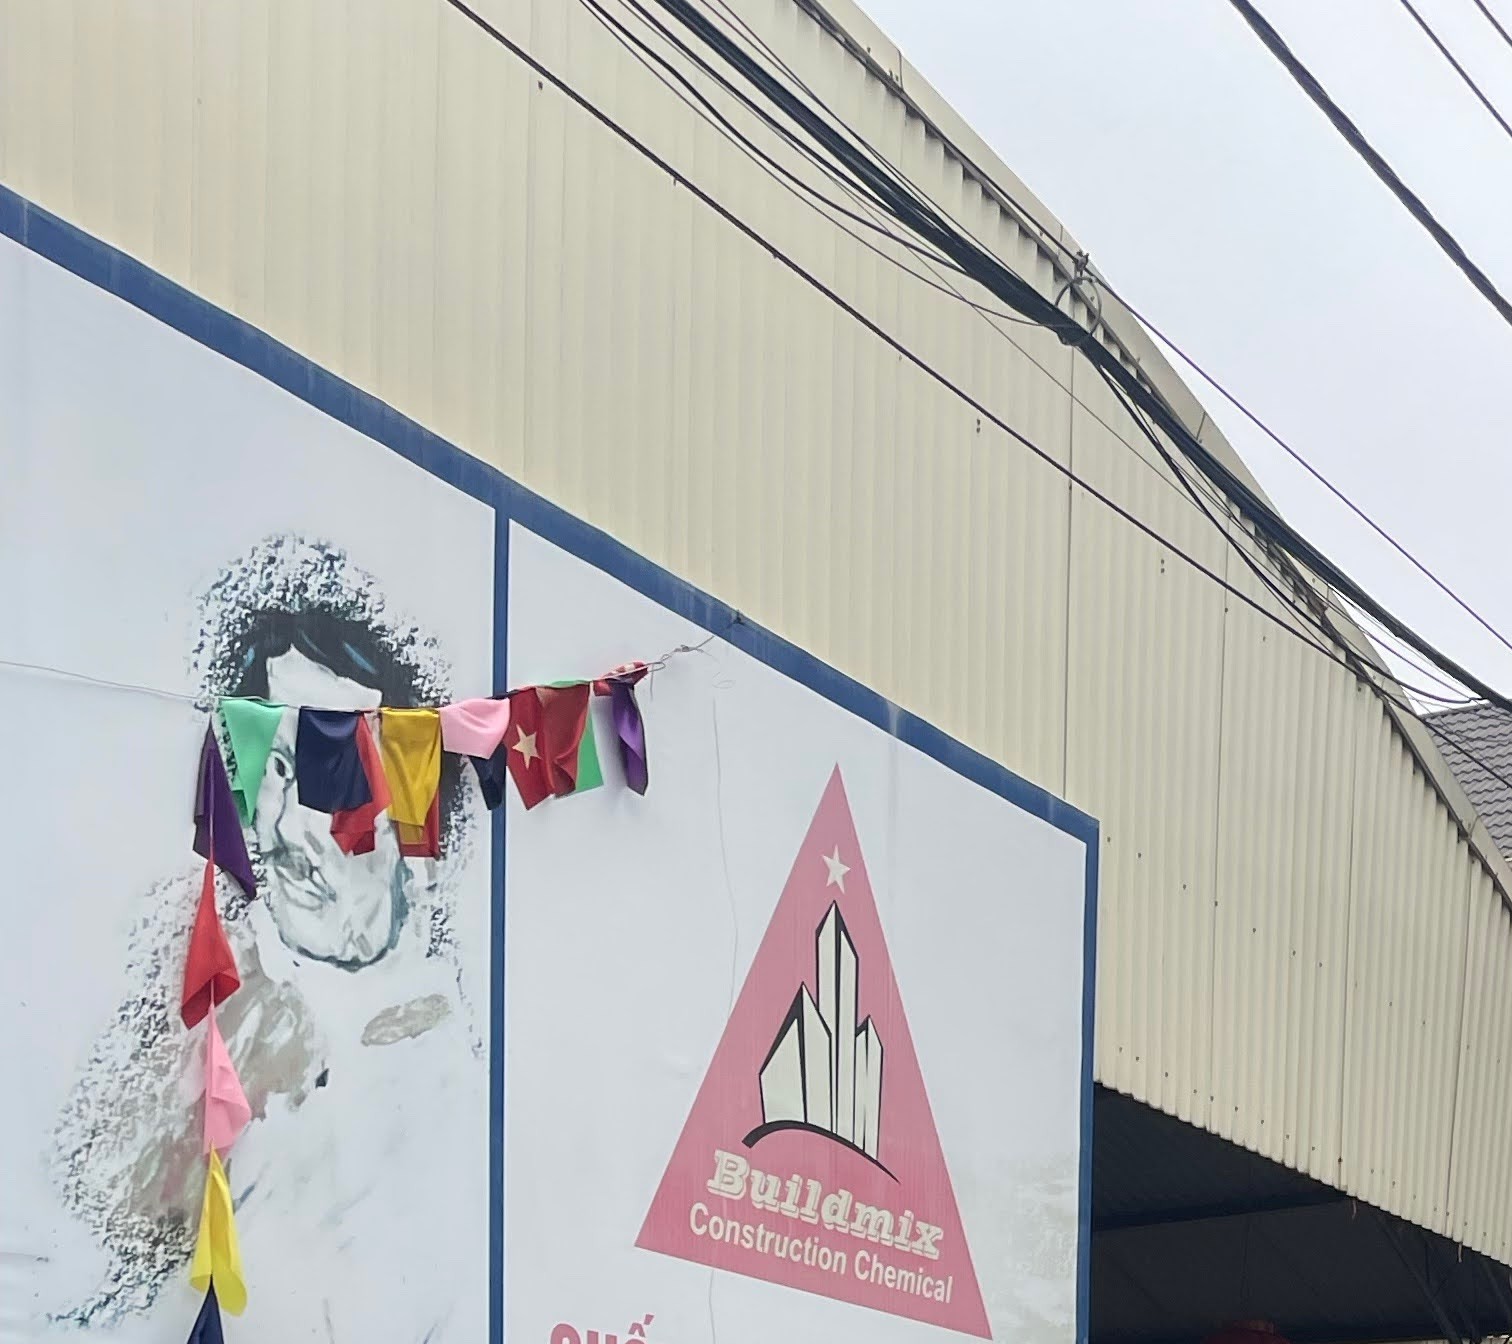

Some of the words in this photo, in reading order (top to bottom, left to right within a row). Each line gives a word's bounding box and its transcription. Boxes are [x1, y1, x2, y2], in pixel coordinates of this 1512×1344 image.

[689, 1201, 848, 1276] Construction
[853, 1249, 954, 1304] Chemical
[706, 1149, 945, 1261] Buildmix
